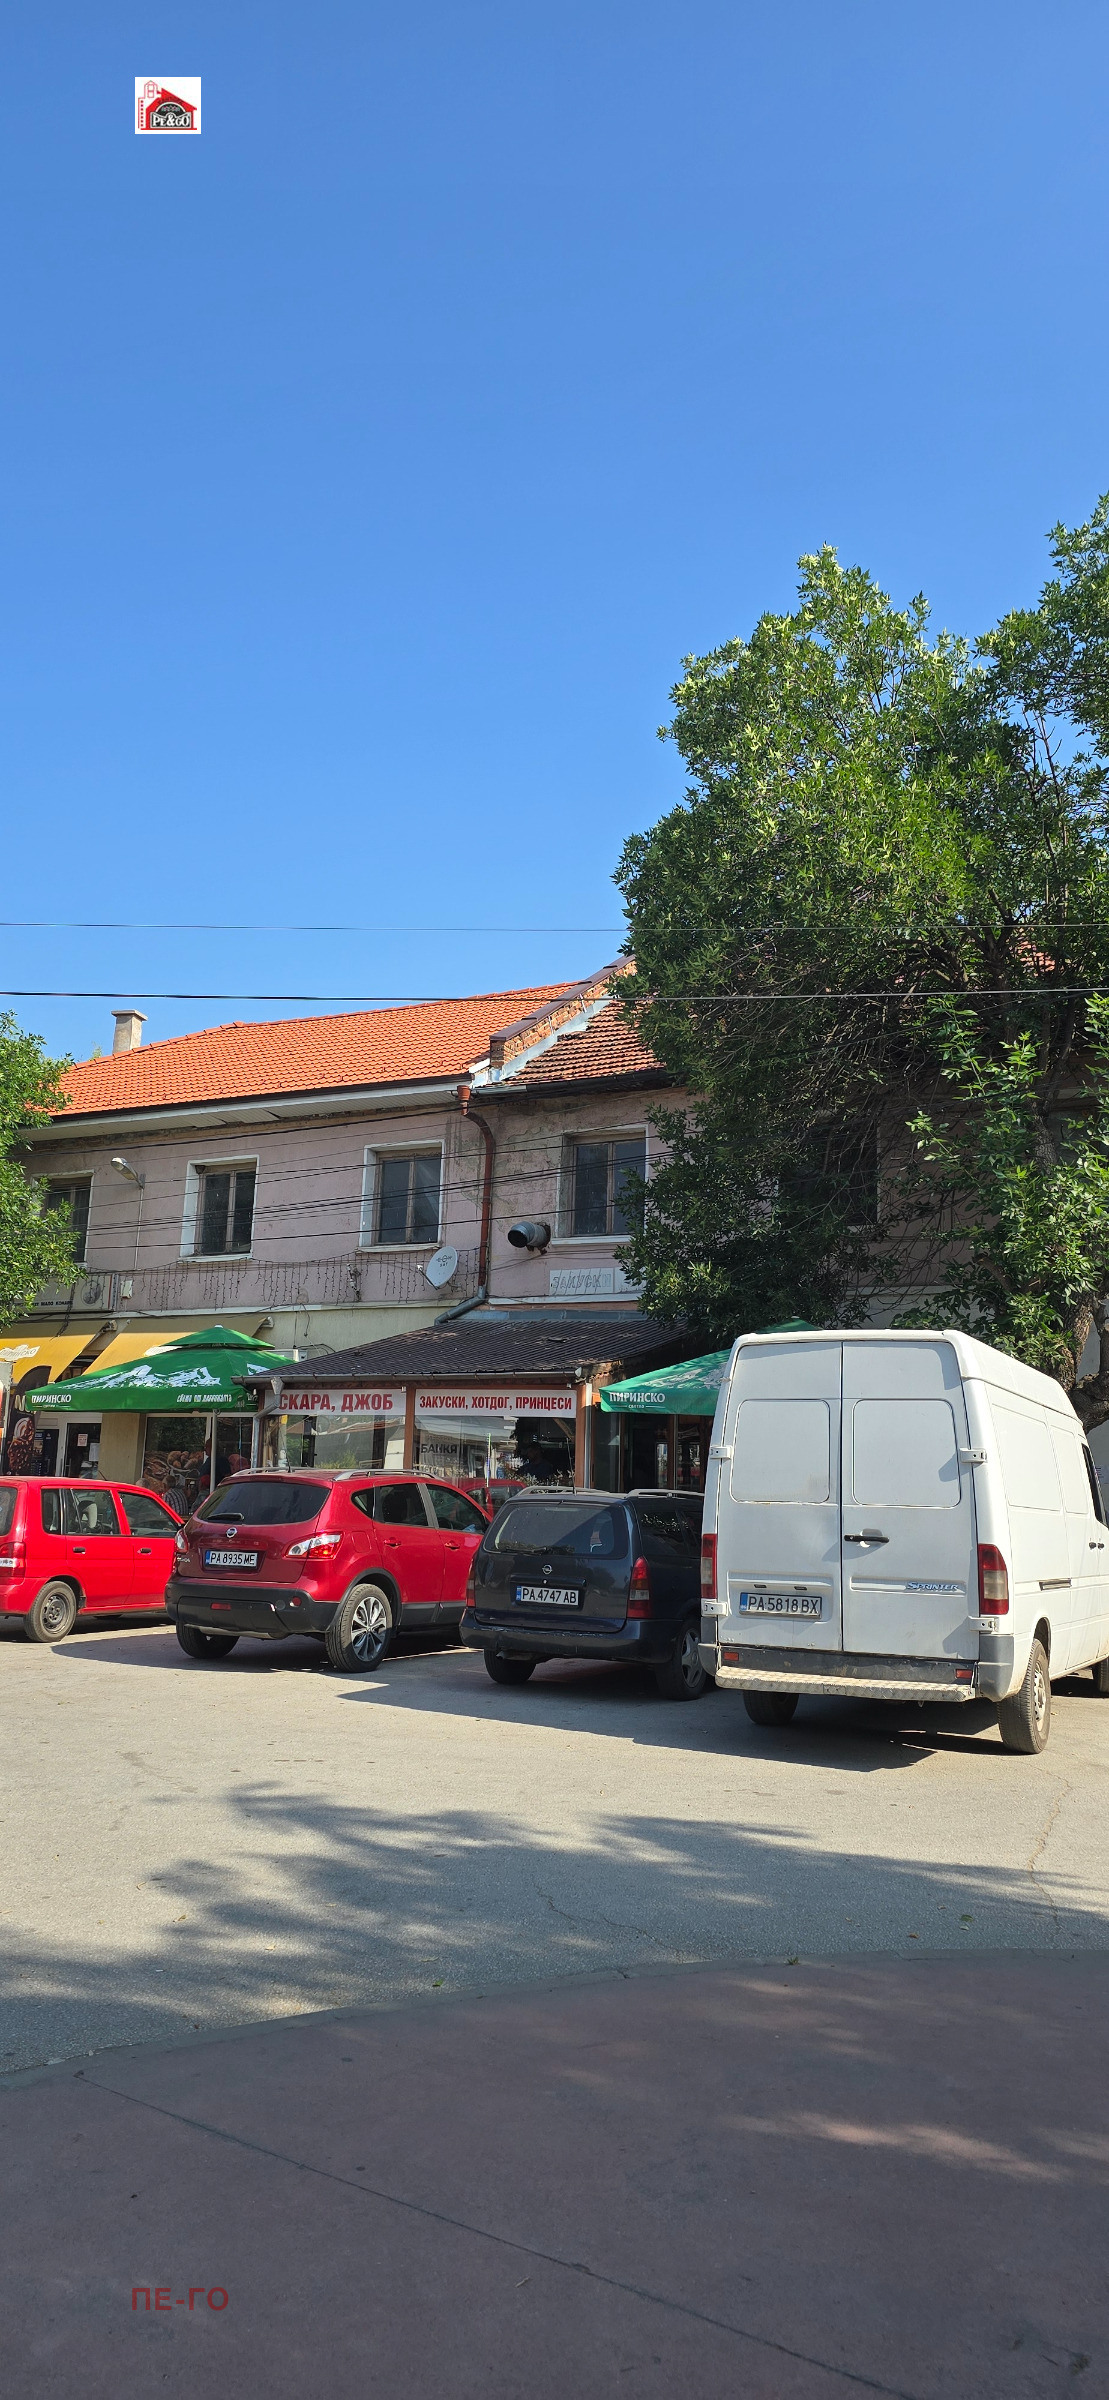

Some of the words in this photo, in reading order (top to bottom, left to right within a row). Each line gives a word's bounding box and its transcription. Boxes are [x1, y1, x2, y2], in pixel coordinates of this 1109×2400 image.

[31, 1394, 72, 1404] ПИРИНСКО
[279, 1393, 336, 1412] СКАРА,
[341, 1393, 393, 1412] ДЖОБ
[419, 1395, 468, 1410] ЗАКУСКИ,
[471, 1396, 513, 1410] ХОТДОГ,
[515, 1396, 572, 1411] ПРИНЦЕСИ
[609, 1392, 666, 1403] ПИРИНСКО
